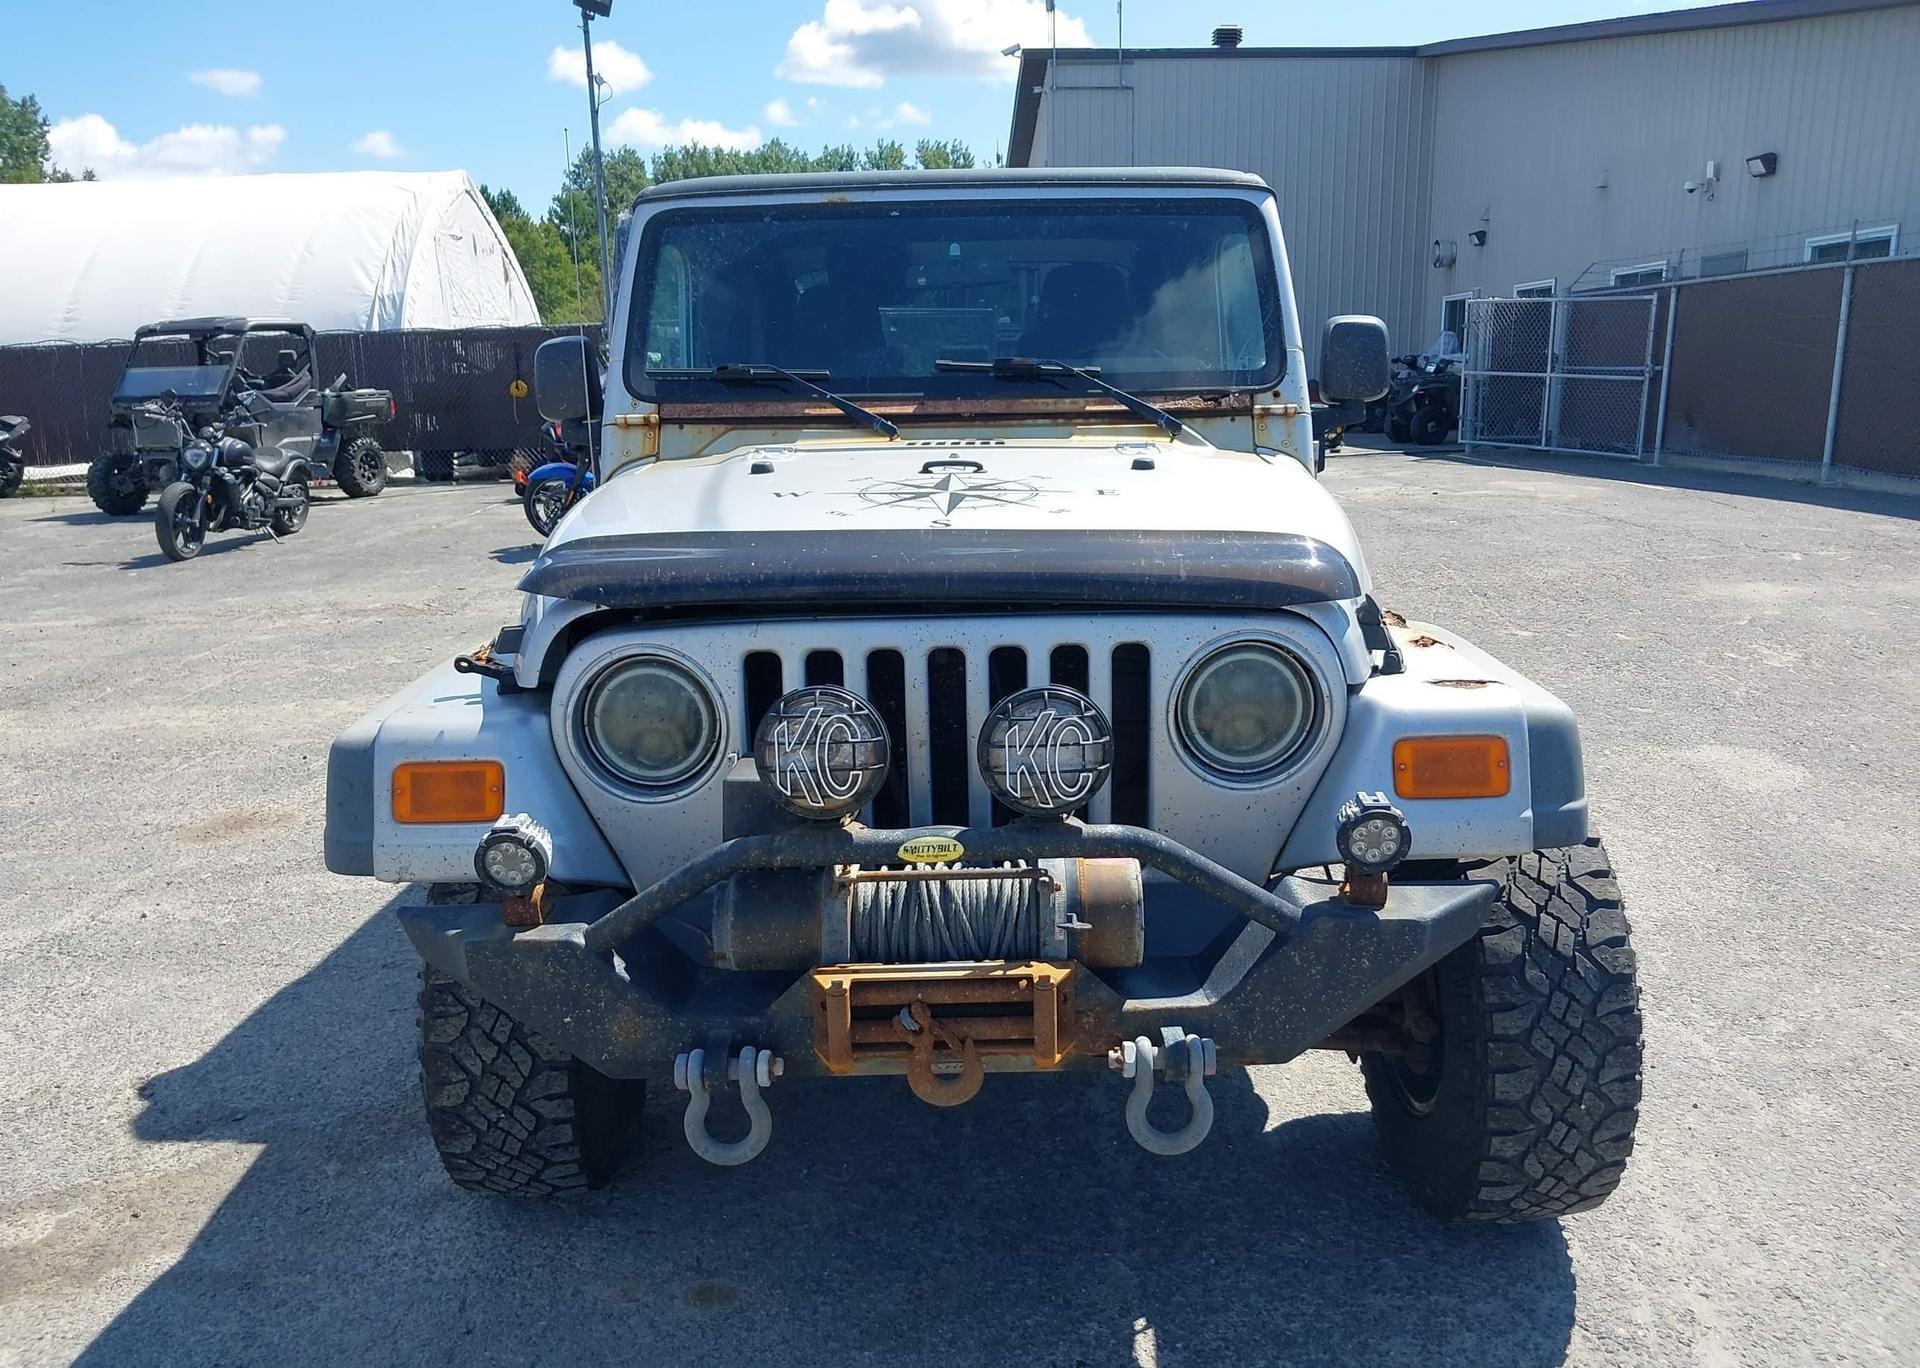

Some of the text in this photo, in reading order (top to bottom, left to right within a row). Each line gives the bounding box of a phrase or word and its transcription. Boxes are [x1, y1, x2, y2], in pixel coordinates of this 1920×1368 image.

[930, 519, 952, 528] S
[774, 707, 863, 807] KC
[1005, 708, 1093, 808] KC
[903, 843, 958, 855] SMITTYBILT
